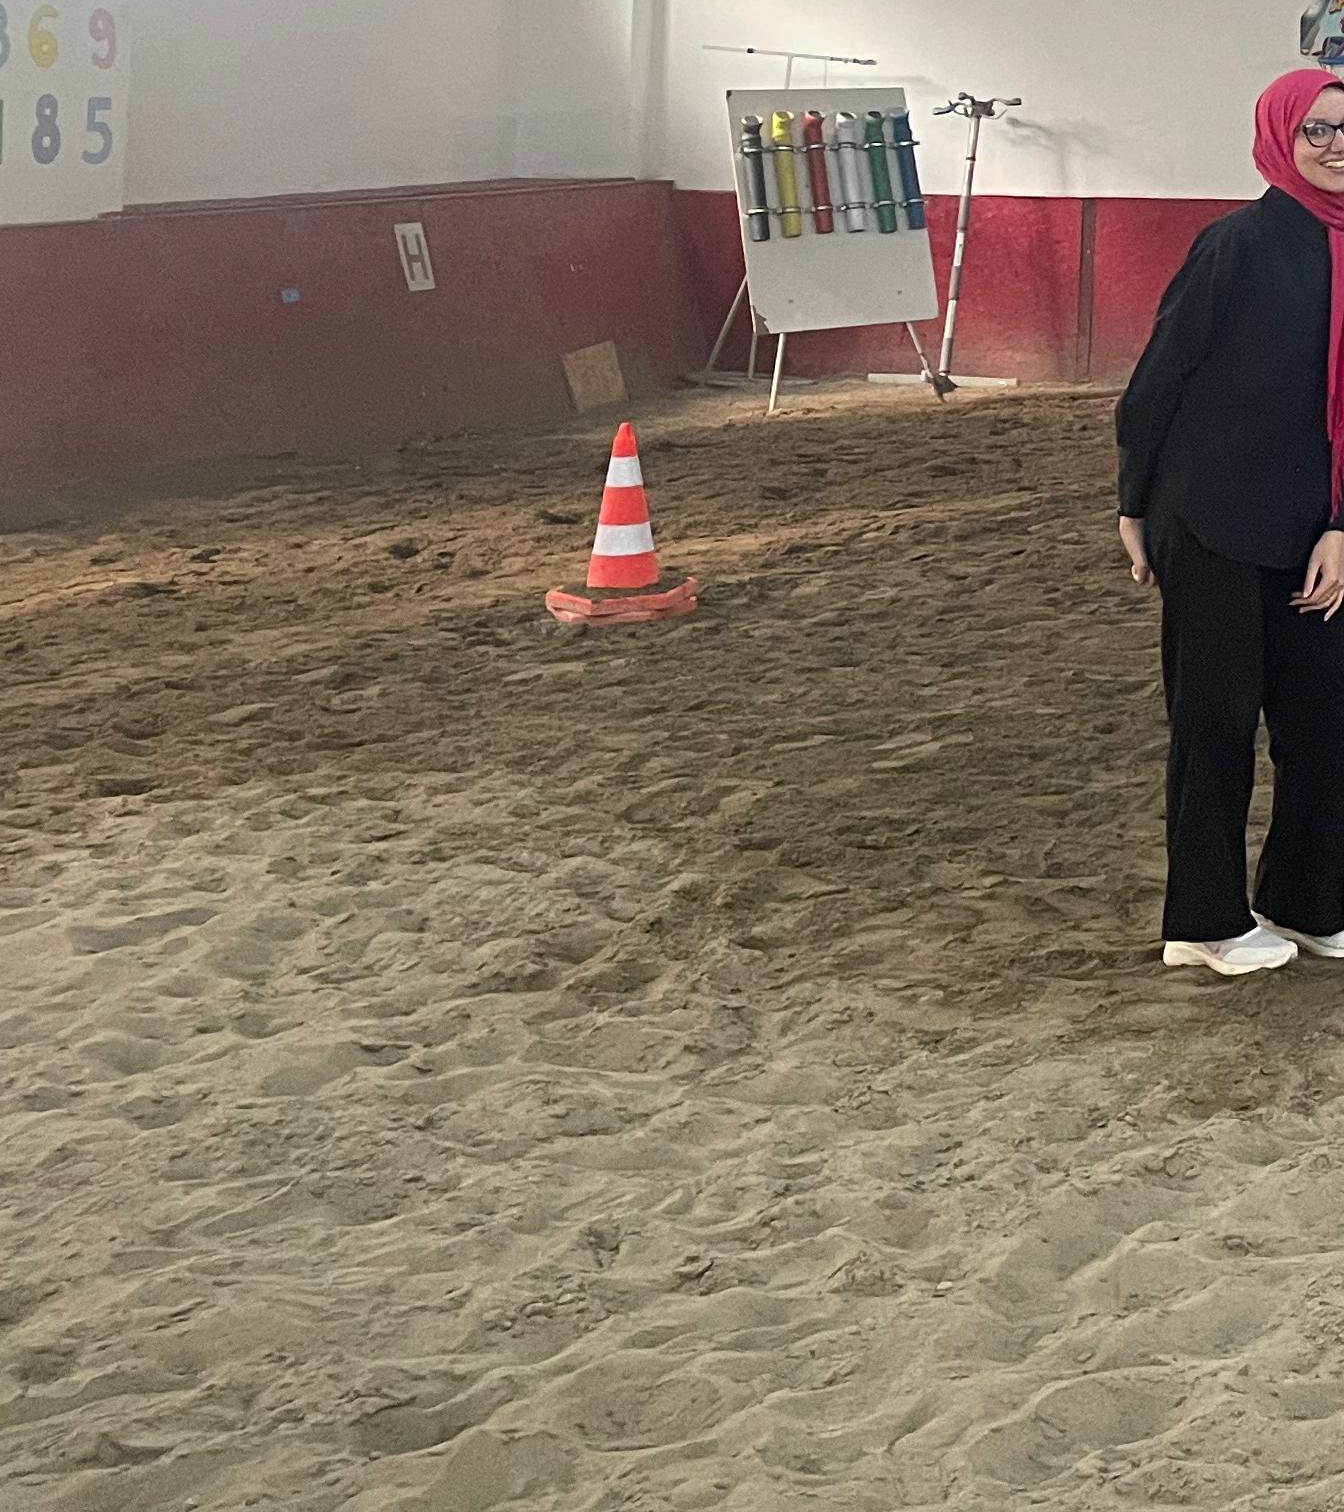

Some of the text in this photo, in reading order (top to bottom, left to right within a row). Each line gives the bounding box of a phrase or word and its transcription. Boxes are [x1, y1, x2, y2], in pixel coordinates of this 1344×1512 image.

[27, 4, 59, 69] 6
[88, 7, 117, 70] 9
[31, 93, 61, 165] 8
[81, 96, 113, 165] 5
[401, 233, 430, 281] H
